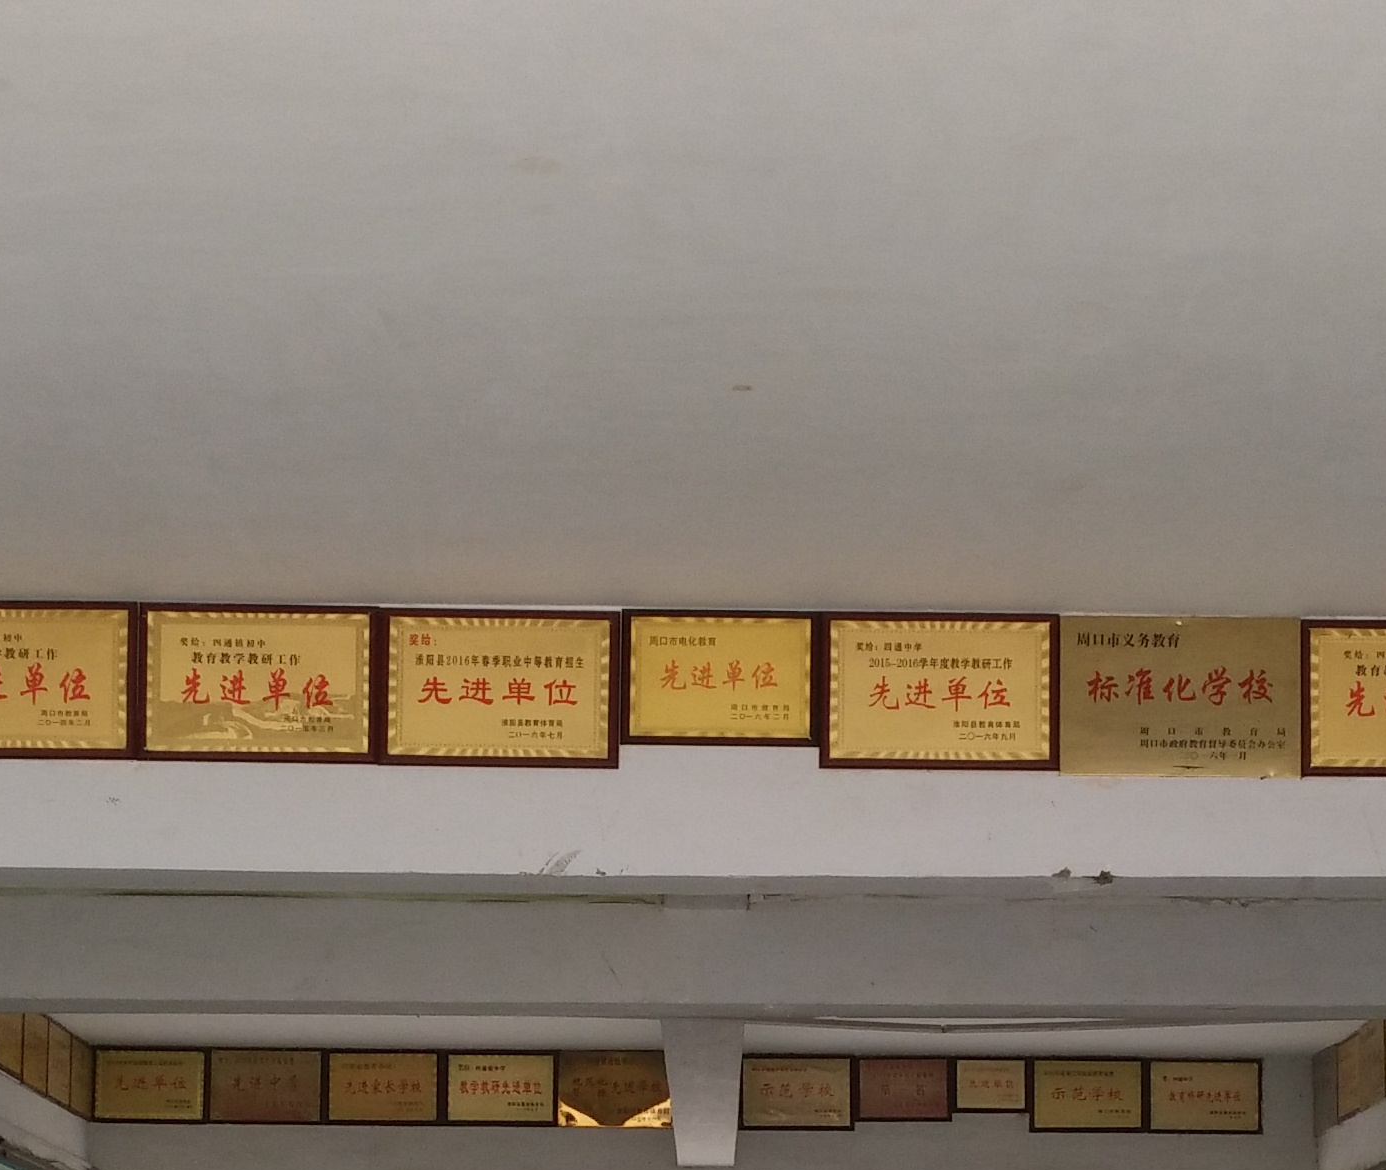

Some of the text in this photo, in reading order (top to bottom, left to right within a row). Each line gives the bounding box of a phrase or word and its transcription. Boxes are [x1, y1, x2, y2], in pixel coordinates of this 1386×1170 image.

[649, 636, 717, 647] 周口市电化教育
[1076, 633, 1181, 649] 周口市义务教育
[191, 651, 300, 666] 教育教学教研工作
[181, 667, 334, 711] 先进单位
[659, 659, 779, 692] 先进单位
[1086, 665, 1273, 706] 标准化学校
[418, 676, 578, 706] 先进单位
[868, 675, 1011, 712] 先进单位
[759, 1081, 836, 1098] 示范学校
